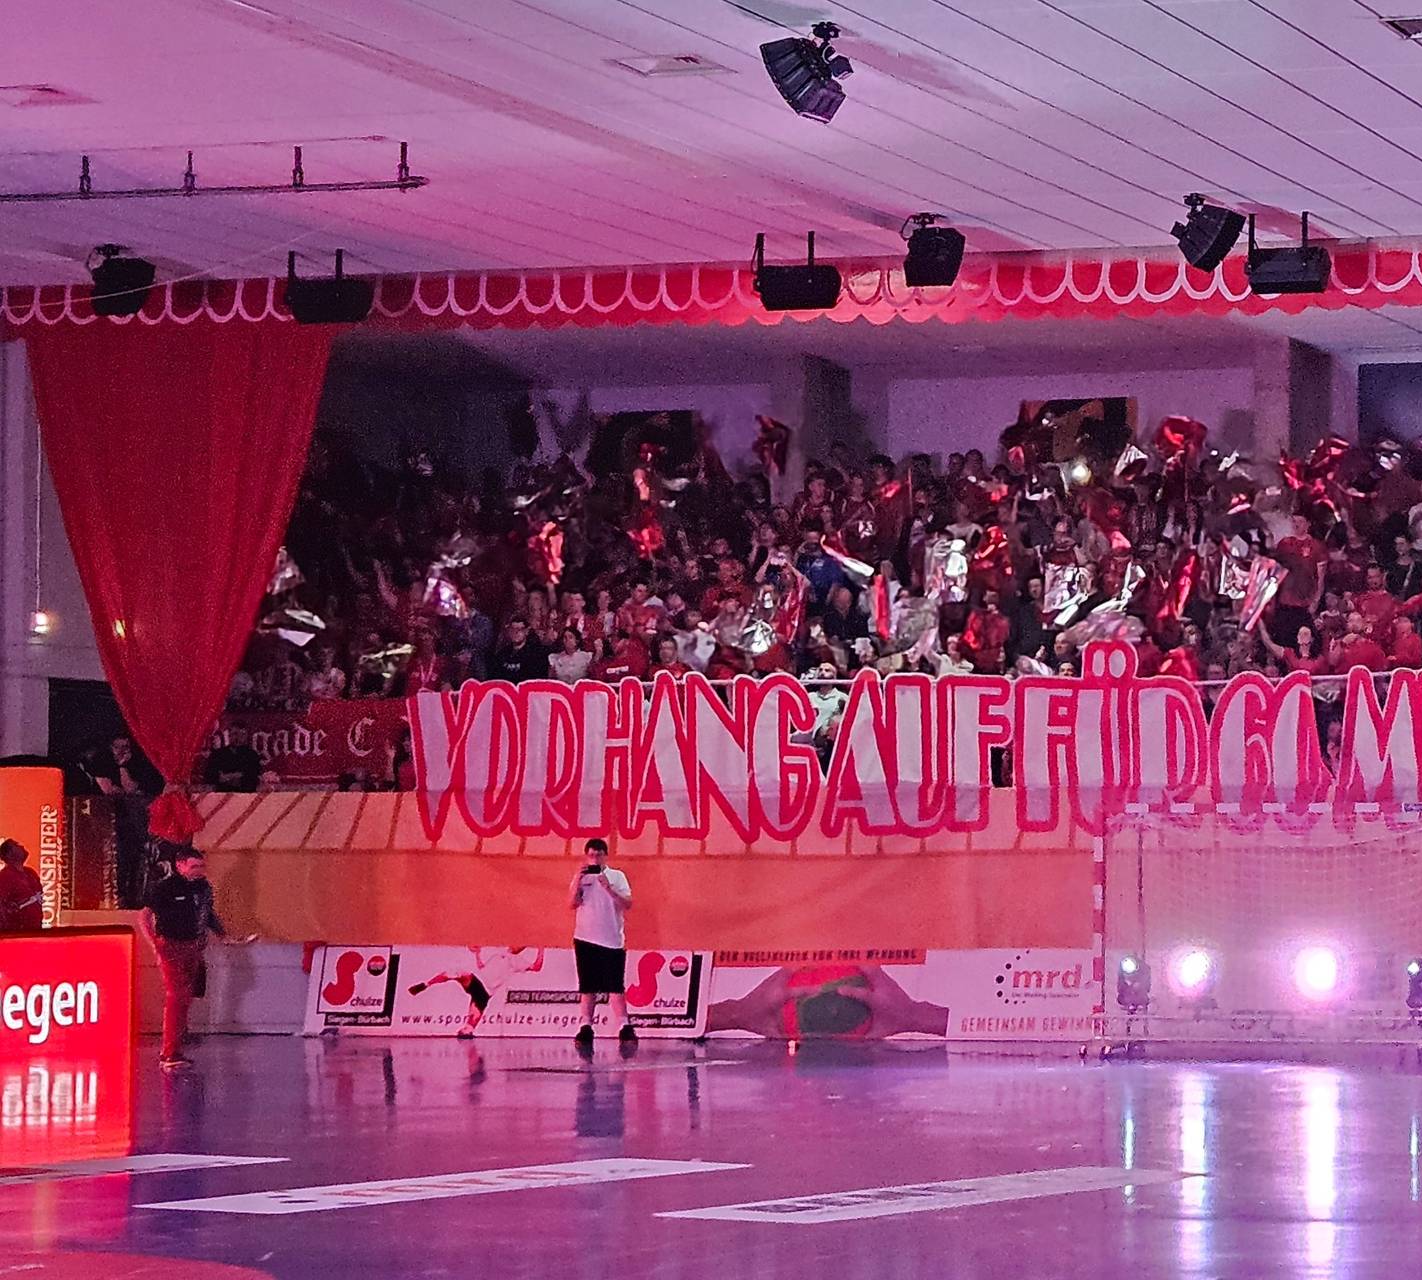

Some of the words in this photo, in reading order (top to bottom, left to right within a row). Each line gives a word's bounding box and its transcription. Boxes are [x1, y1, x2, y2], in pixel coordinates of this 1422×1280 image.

[406, 669, 821, 842] VORHANG
[821, 667, 1013, 839] AUF
[1014, 640, 1208, 835] FÜR
[1209, 670, 1334, 835] 60
[1012, 963, 1083, 989] mrd
[0, 980, 98, 1044] egen
